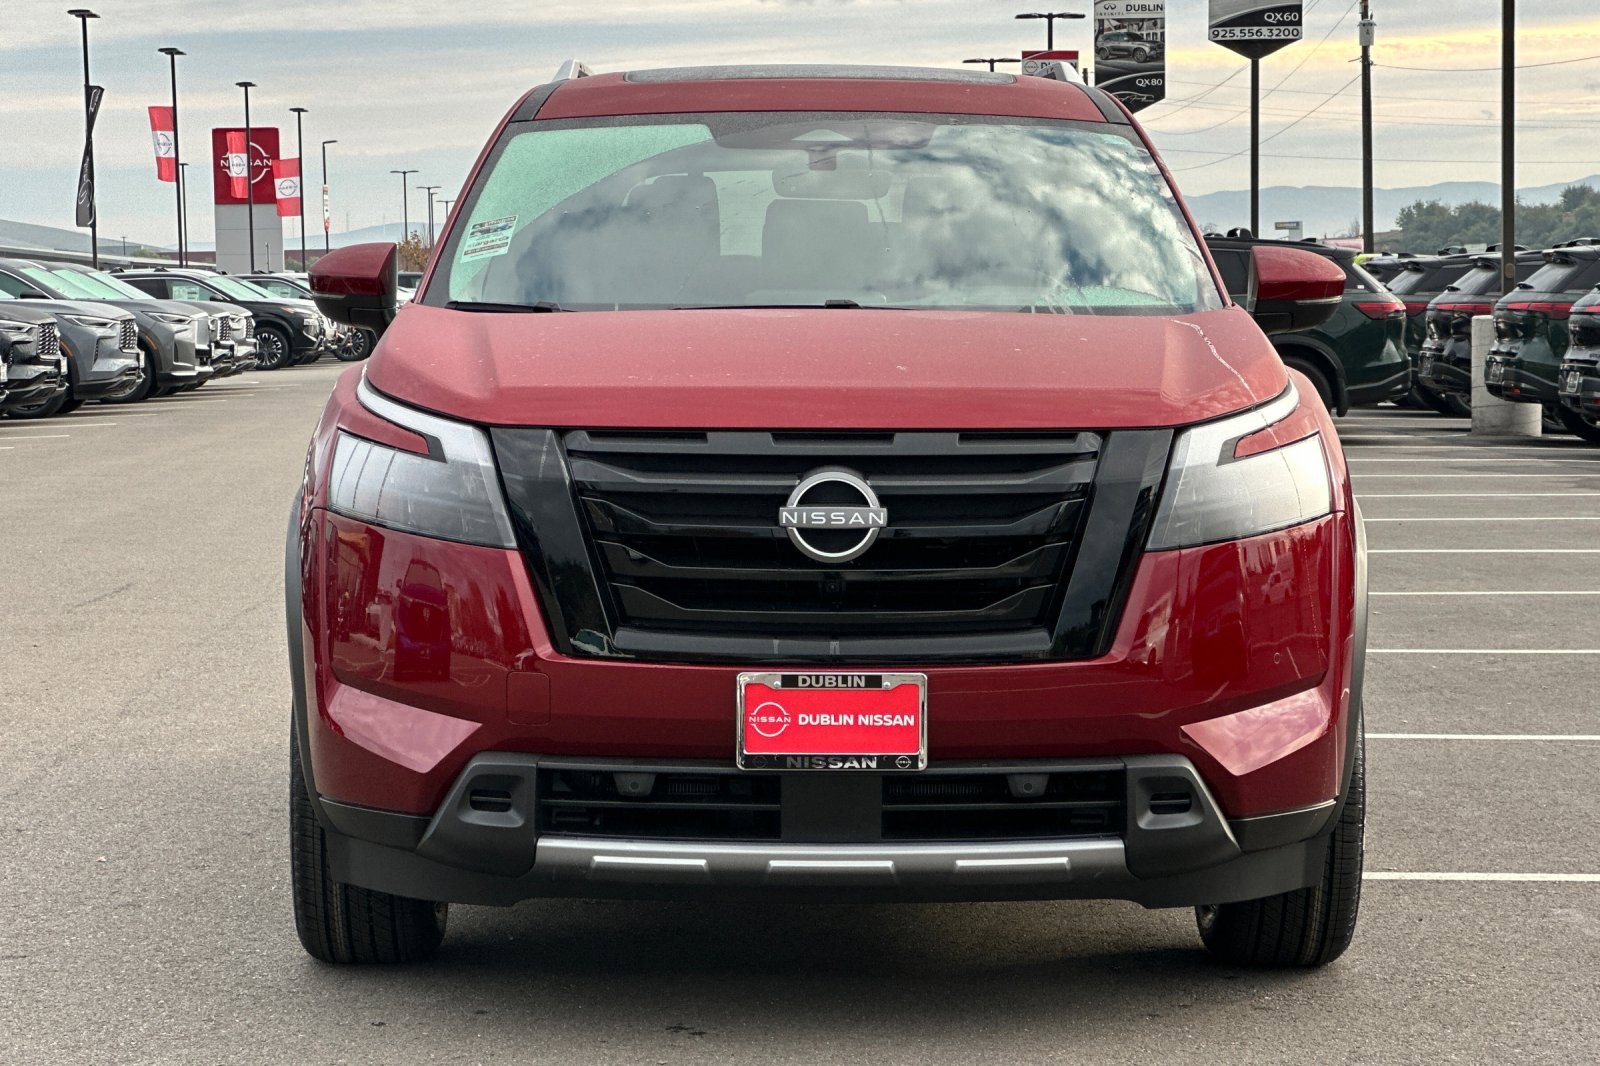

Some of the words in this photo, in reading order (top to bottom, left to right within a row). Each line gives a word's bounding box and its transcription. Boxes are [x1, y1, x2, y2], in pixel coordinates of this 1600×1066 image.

[1264, 12, 1299, 24] QX60
[1212, 28, 1300, 38] 925.556.3200
[1136, 78, 1162, 87] QX80
[220, 159, 272, 167] NAN
[782, 512, 884, 524] NISSAN
[798, 676, 866, 688] DUBLIN
[798, 714, 854, 726] DUBLIN
[858, 714, 914, 726] NISSAN
[786, 756, 877, 768] NISSAN
